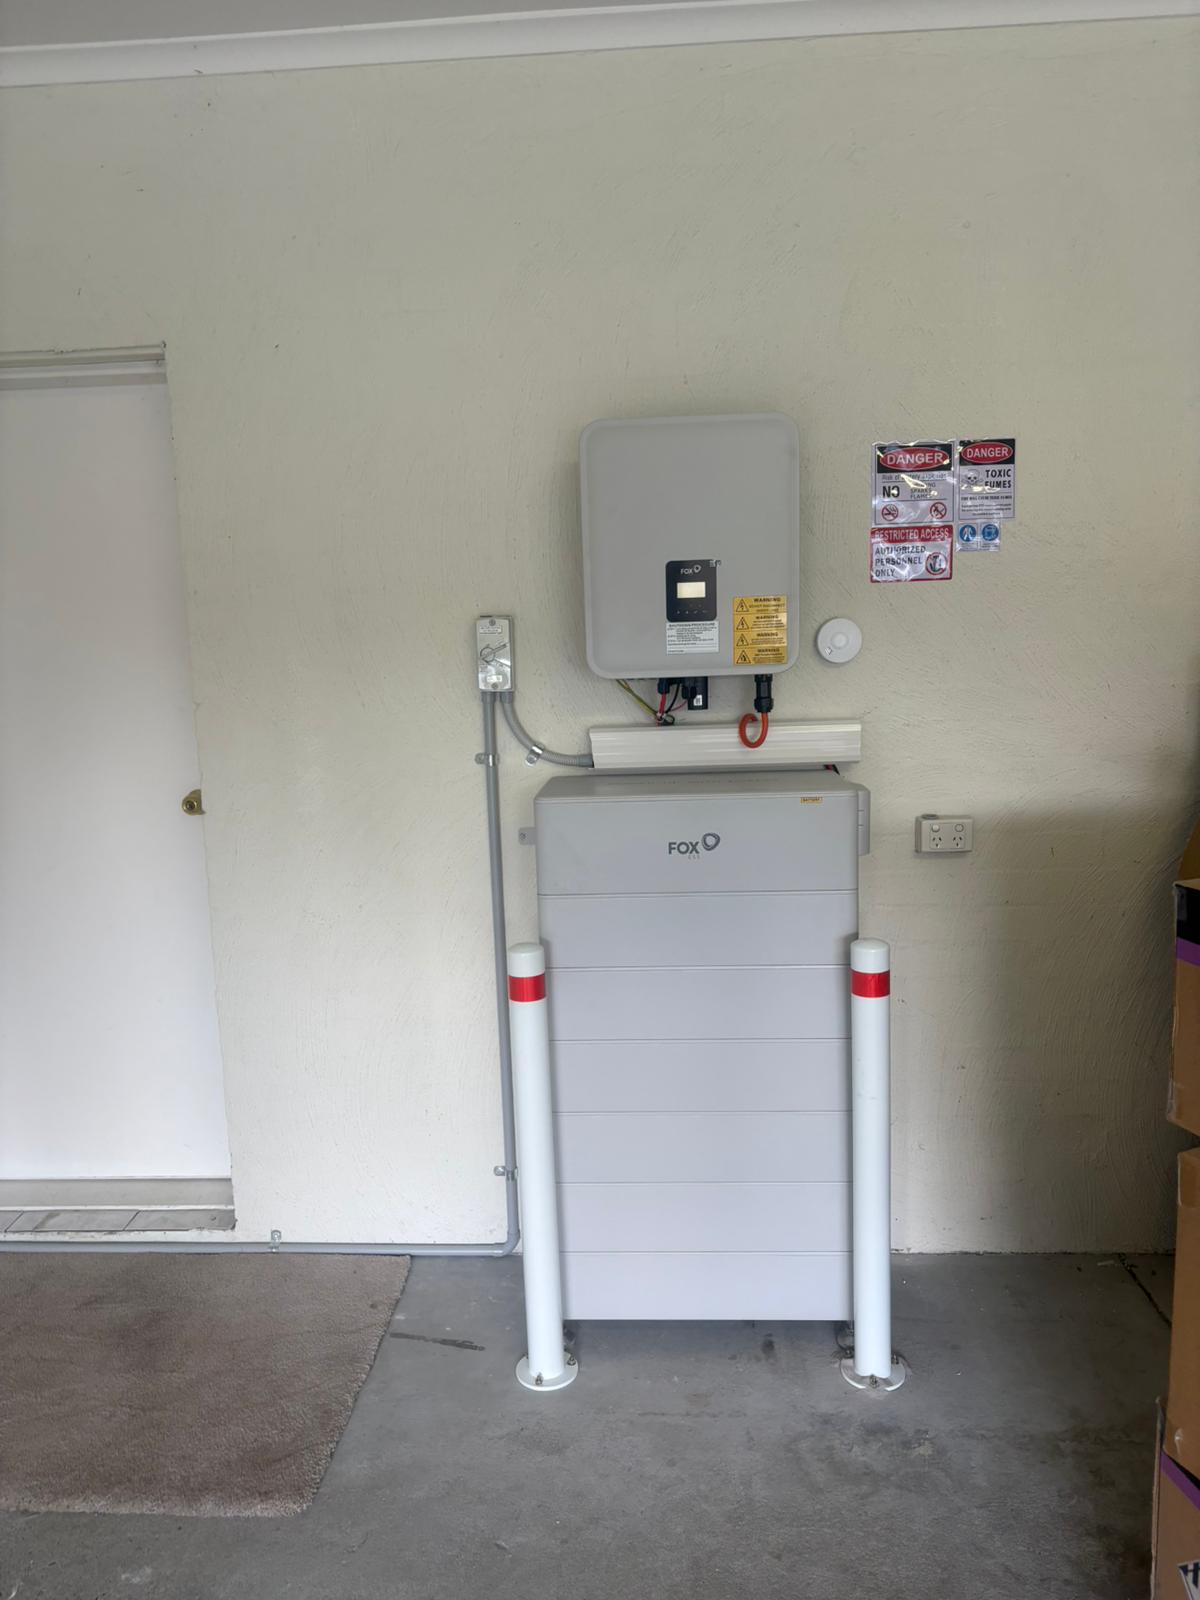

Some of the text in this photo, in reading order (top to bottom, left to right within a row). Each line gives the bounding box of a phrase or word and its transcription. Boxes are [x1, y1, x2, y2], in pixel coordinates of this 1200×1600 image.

[966, 446, 1009, 459] DANGER
[887, 452, 943, 465] DANGER
[985, 468, 1012, 478] TOXIC
[985, 480, 1012, 489] FUMES
[882, 485, 900, 498] NO
[874, 527, 950, 540] RESTRICTED ACCESS
[875, 545, 926, 555] AUTHORIZED
[875, 556, 923, 566] PERSONNEL
[680, 567, 693, 575] FOX
[875, 568, 896, 577] ONLY
[668, 841, 700, 855] FOX
